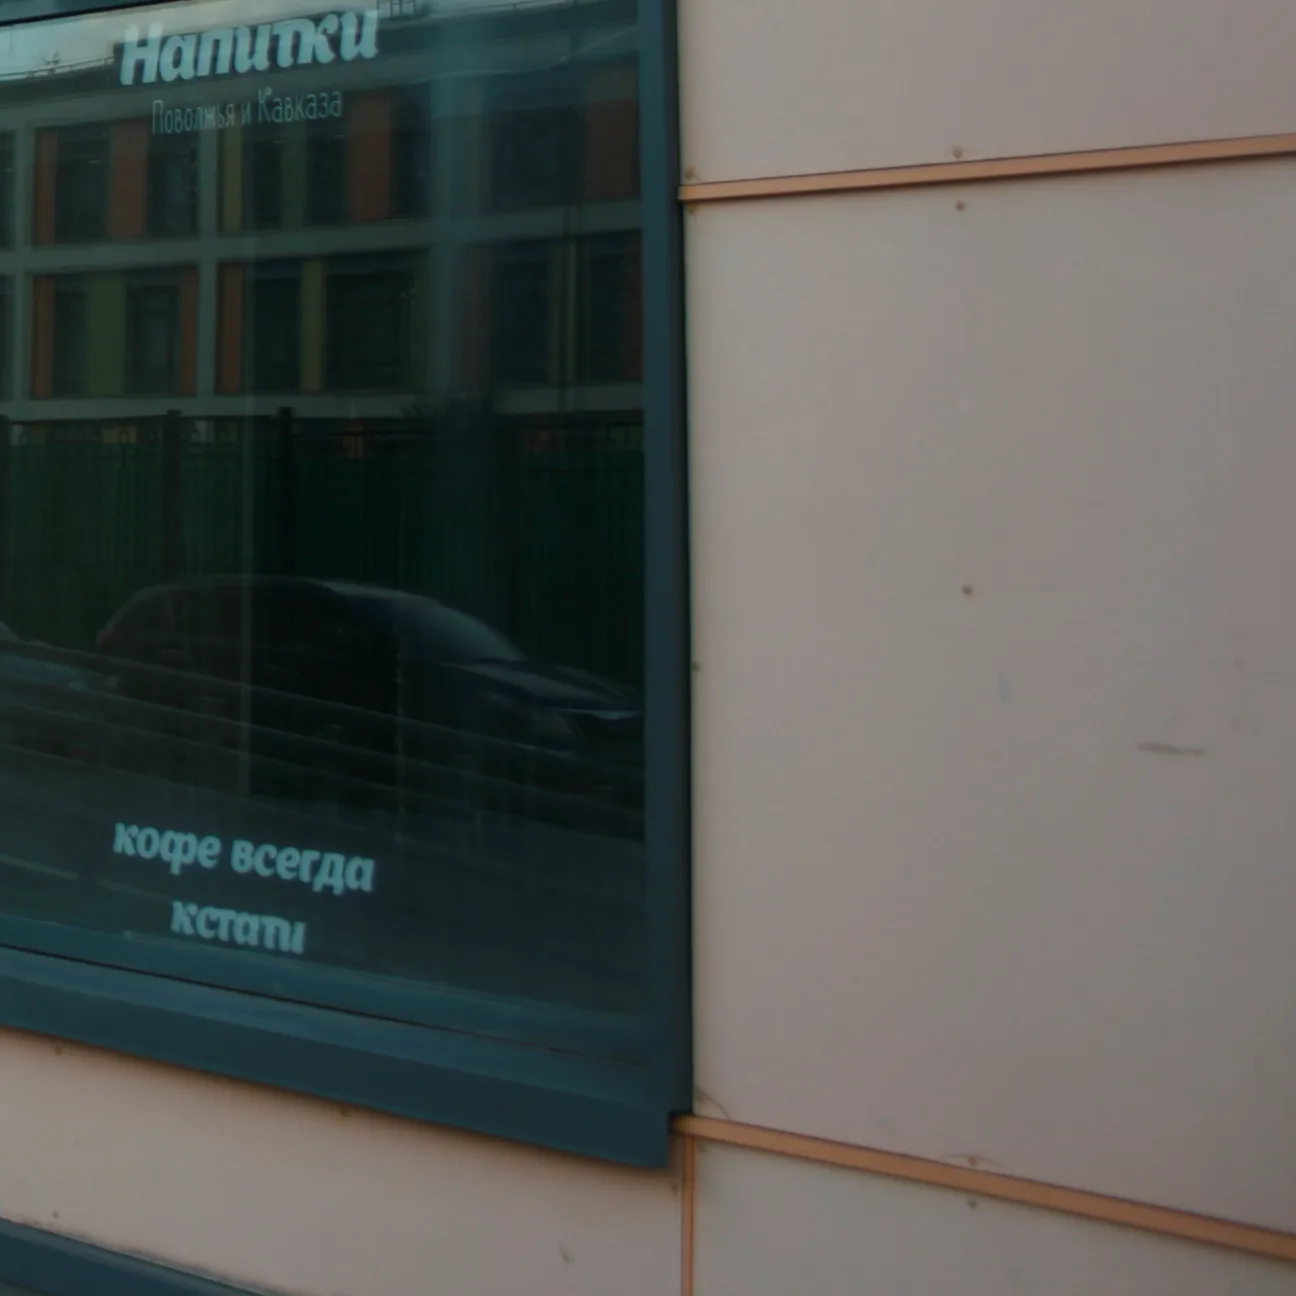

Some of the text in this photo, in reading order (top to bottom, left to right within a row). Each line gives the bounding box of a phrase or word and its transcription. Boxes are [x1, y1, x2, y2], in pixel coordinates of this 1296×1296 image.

[119, 9, 380, 86] Напитки
[151, 86, 343, 136] Поволжья и Кавказа
[112, 821, 376, 896] кофе всегда
[170, 900, 308, 954] кстати
